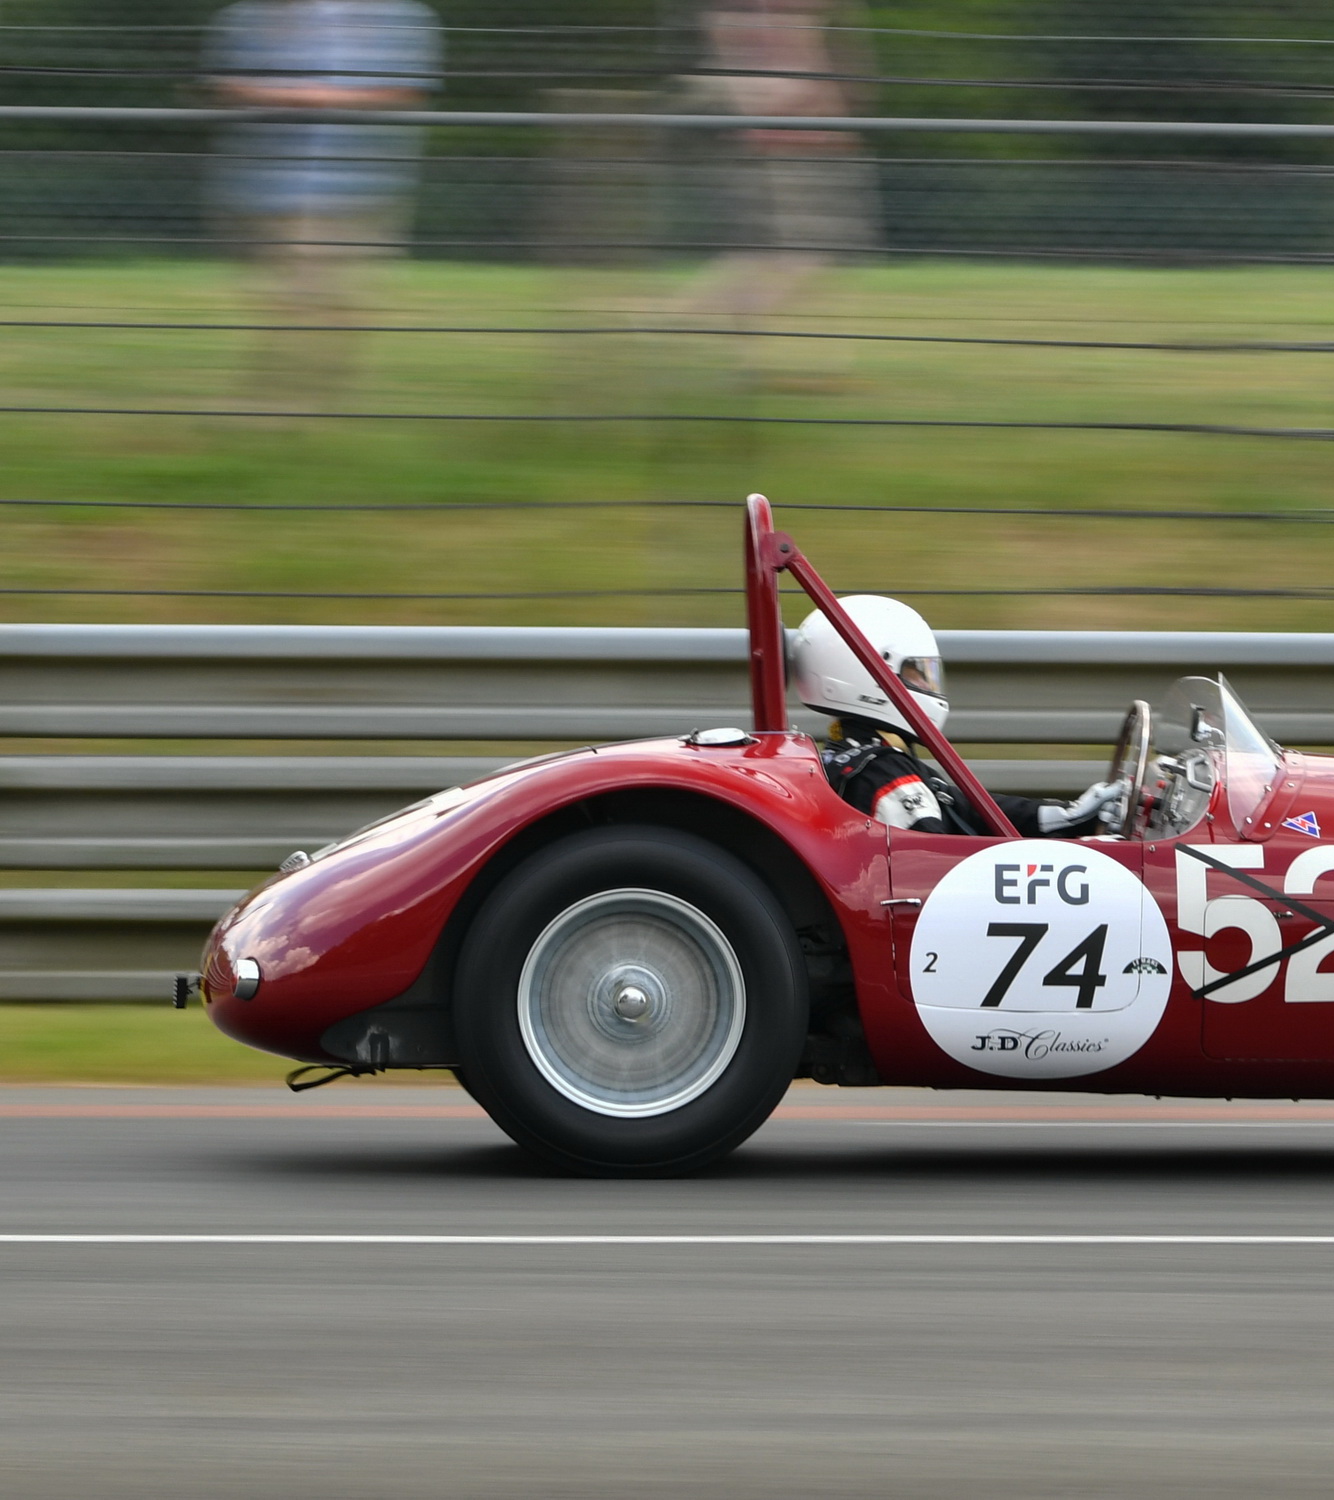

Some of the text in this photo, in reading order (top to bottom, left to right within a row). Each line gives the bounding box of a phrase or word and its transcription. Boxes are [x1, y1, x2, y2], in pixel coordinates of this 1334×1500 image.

[995, 864, 1089, 905] EFG
[922, 952, 938, 973] 2
[980, 922, 1108, 1008] 74
[1025, 1030, 1104, 1060] Classics
